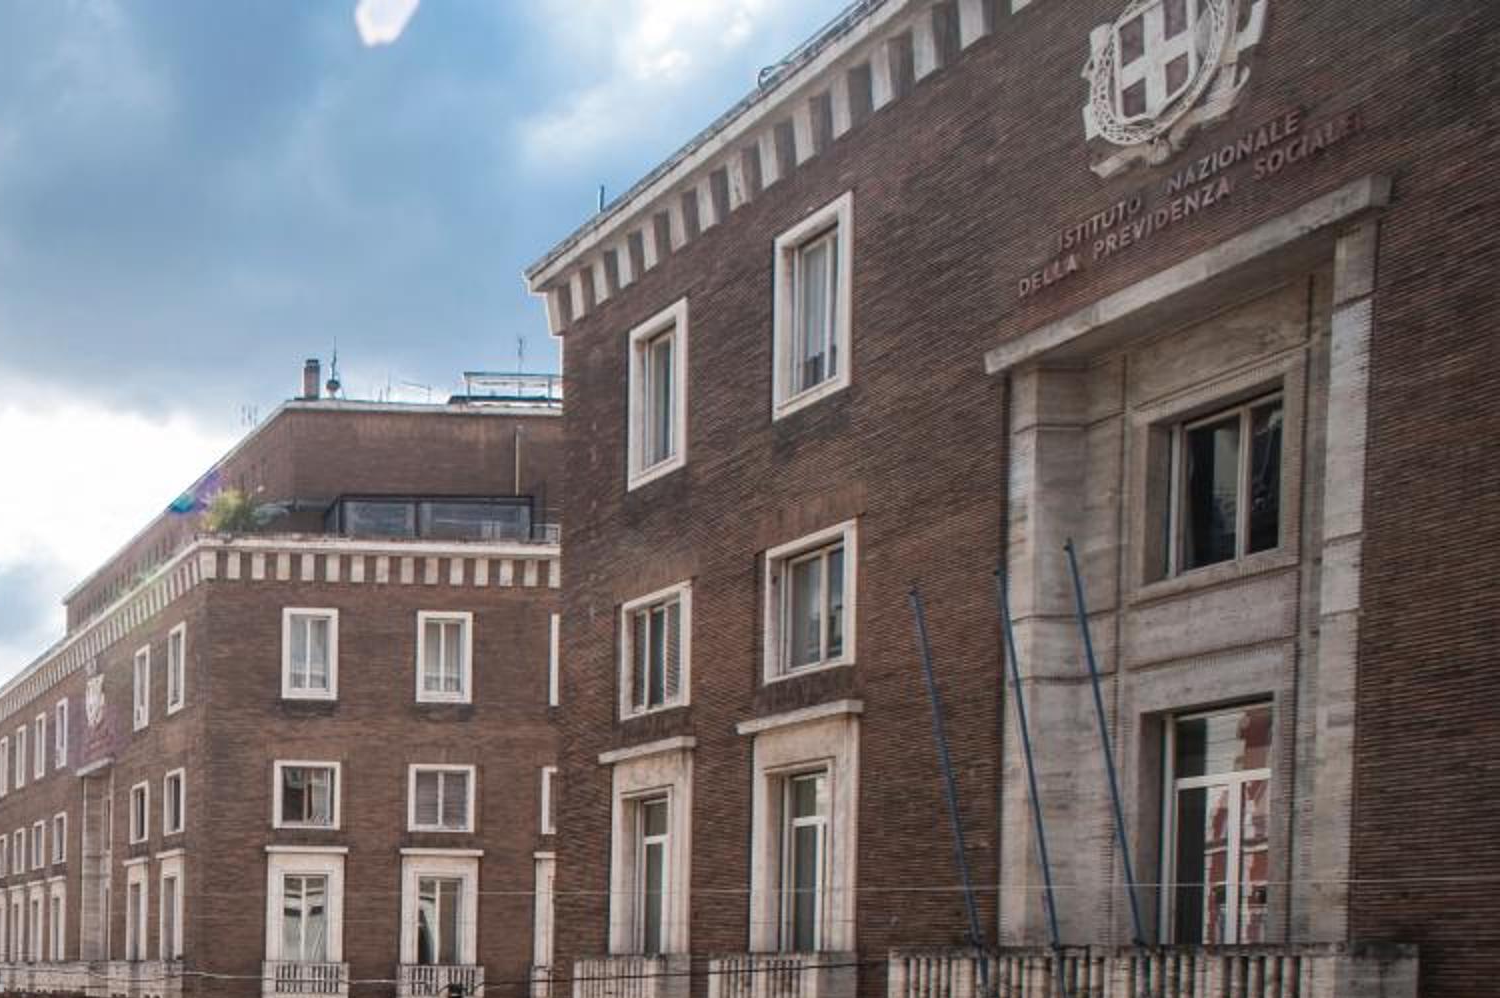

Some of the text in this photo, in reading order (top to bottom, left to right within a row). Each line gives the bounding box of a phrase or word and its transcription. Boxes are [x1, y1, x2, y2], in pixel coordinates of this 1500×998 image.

[1018, 253, 1079, 298] DELLA
[1092, 176, 1233, 260] PREVIDENZA
[1060, 111, 1300, 250] ISTITUTO NAZIONALE
